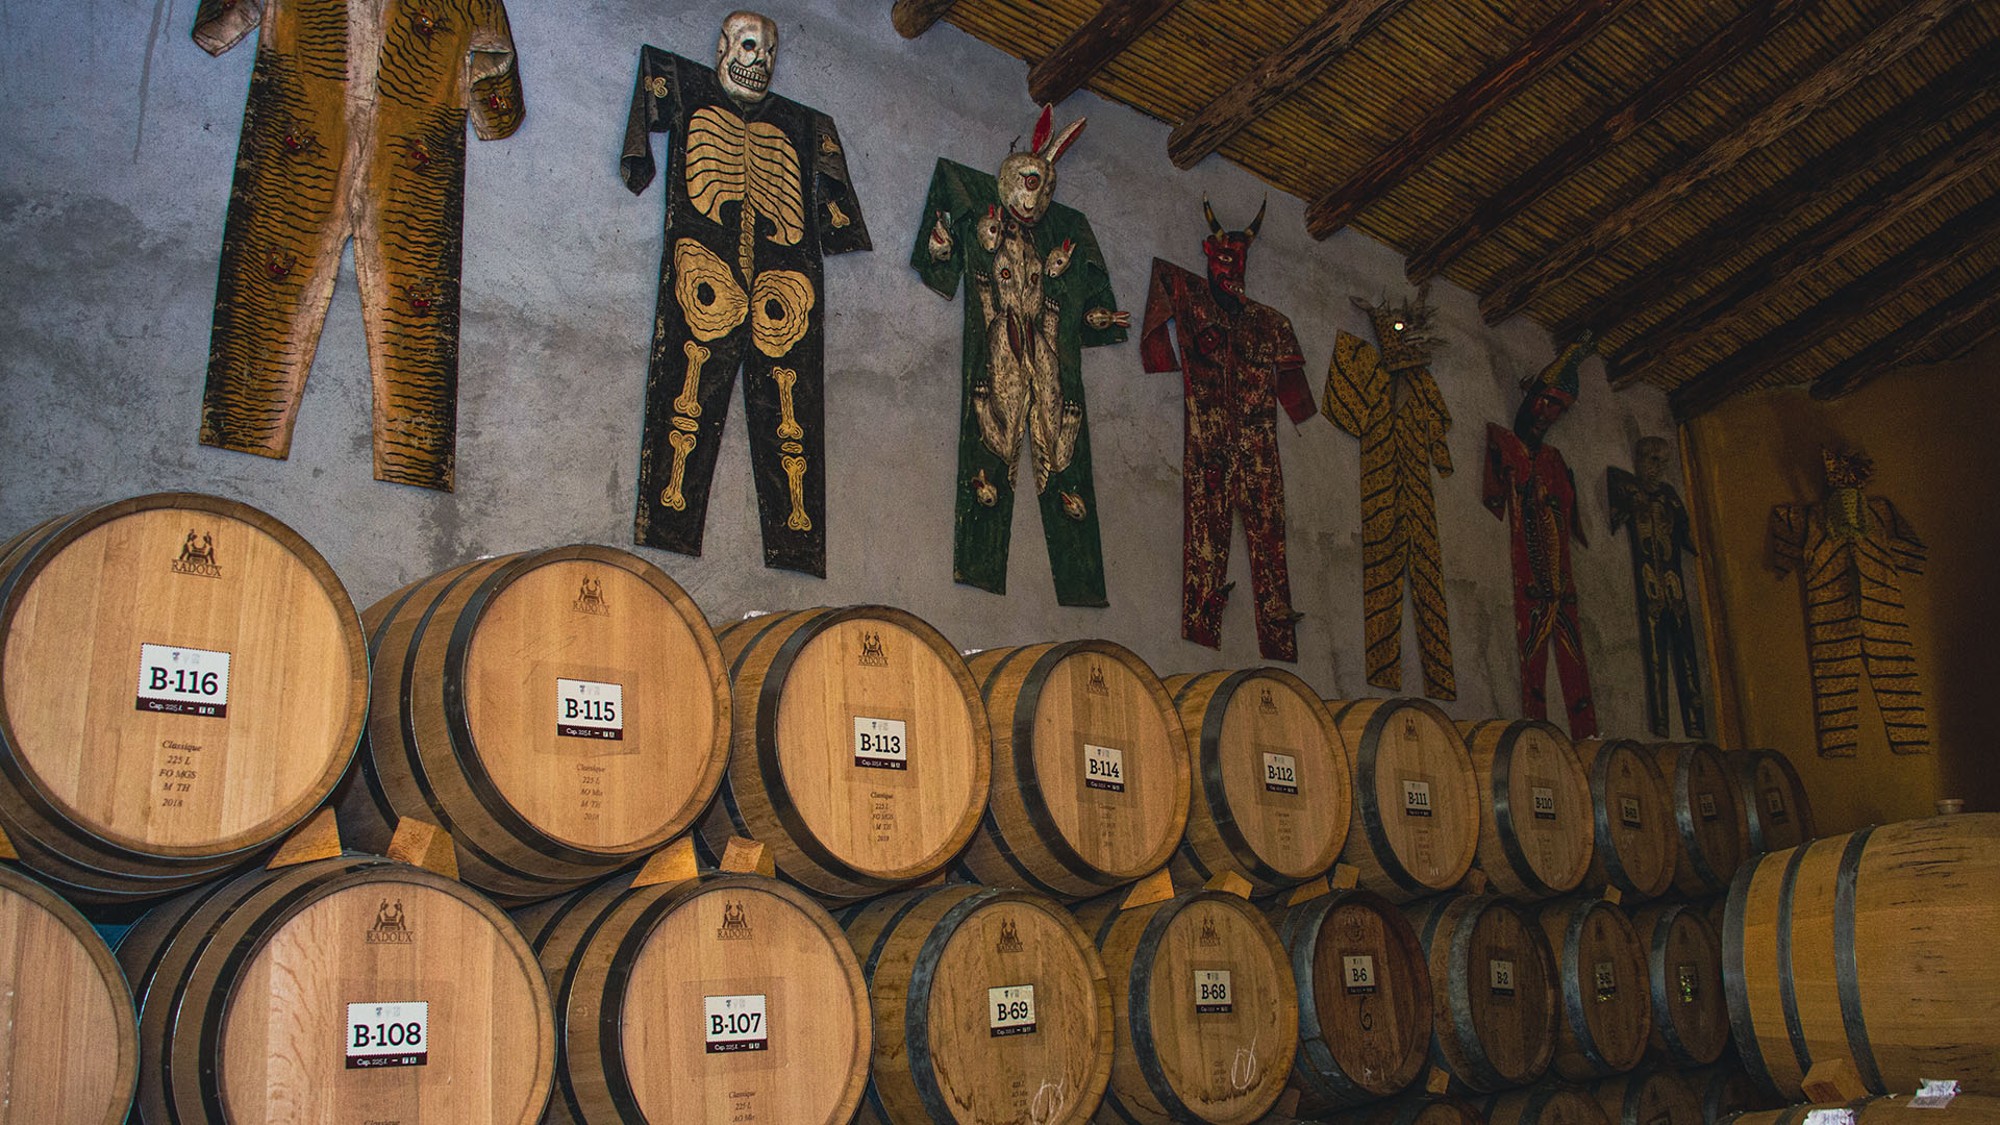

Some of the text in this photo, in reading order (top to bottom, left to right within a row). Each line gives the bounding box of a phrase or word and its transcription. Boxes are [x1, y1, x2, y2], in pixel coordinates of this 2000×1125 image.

[171, 559, 222, 577] RADOUX
[573, 600, 610, 616] RADOUX
[149, 666, 219, 696] B-116
[565, 698, 615, 722] B-115
[162, 739, 202, 752] Classique
[860, 733, 901, 754] B-113
[167, 755, 191, 765] 225 L
[1089, 758, 1120, 778] B-114
[1268, 764, 1294, 782] B-112
[163, 782, 191, 792] M TH
[162, 798, 183, 807] 2018
[366, 930, 414, 943] RADOUX
[717, 928, 753, 940] RADOUX
[1352, 967, 1368, 982] B-6
[1497, 971, 1509, 985] B-2
[1201, 983, 1226, 1000] B-68
[997, 1001, 1028, 1021] B-69
[711, 1013, 762, 1035] B-107
[353, 1022, 422, 1048] B-108
